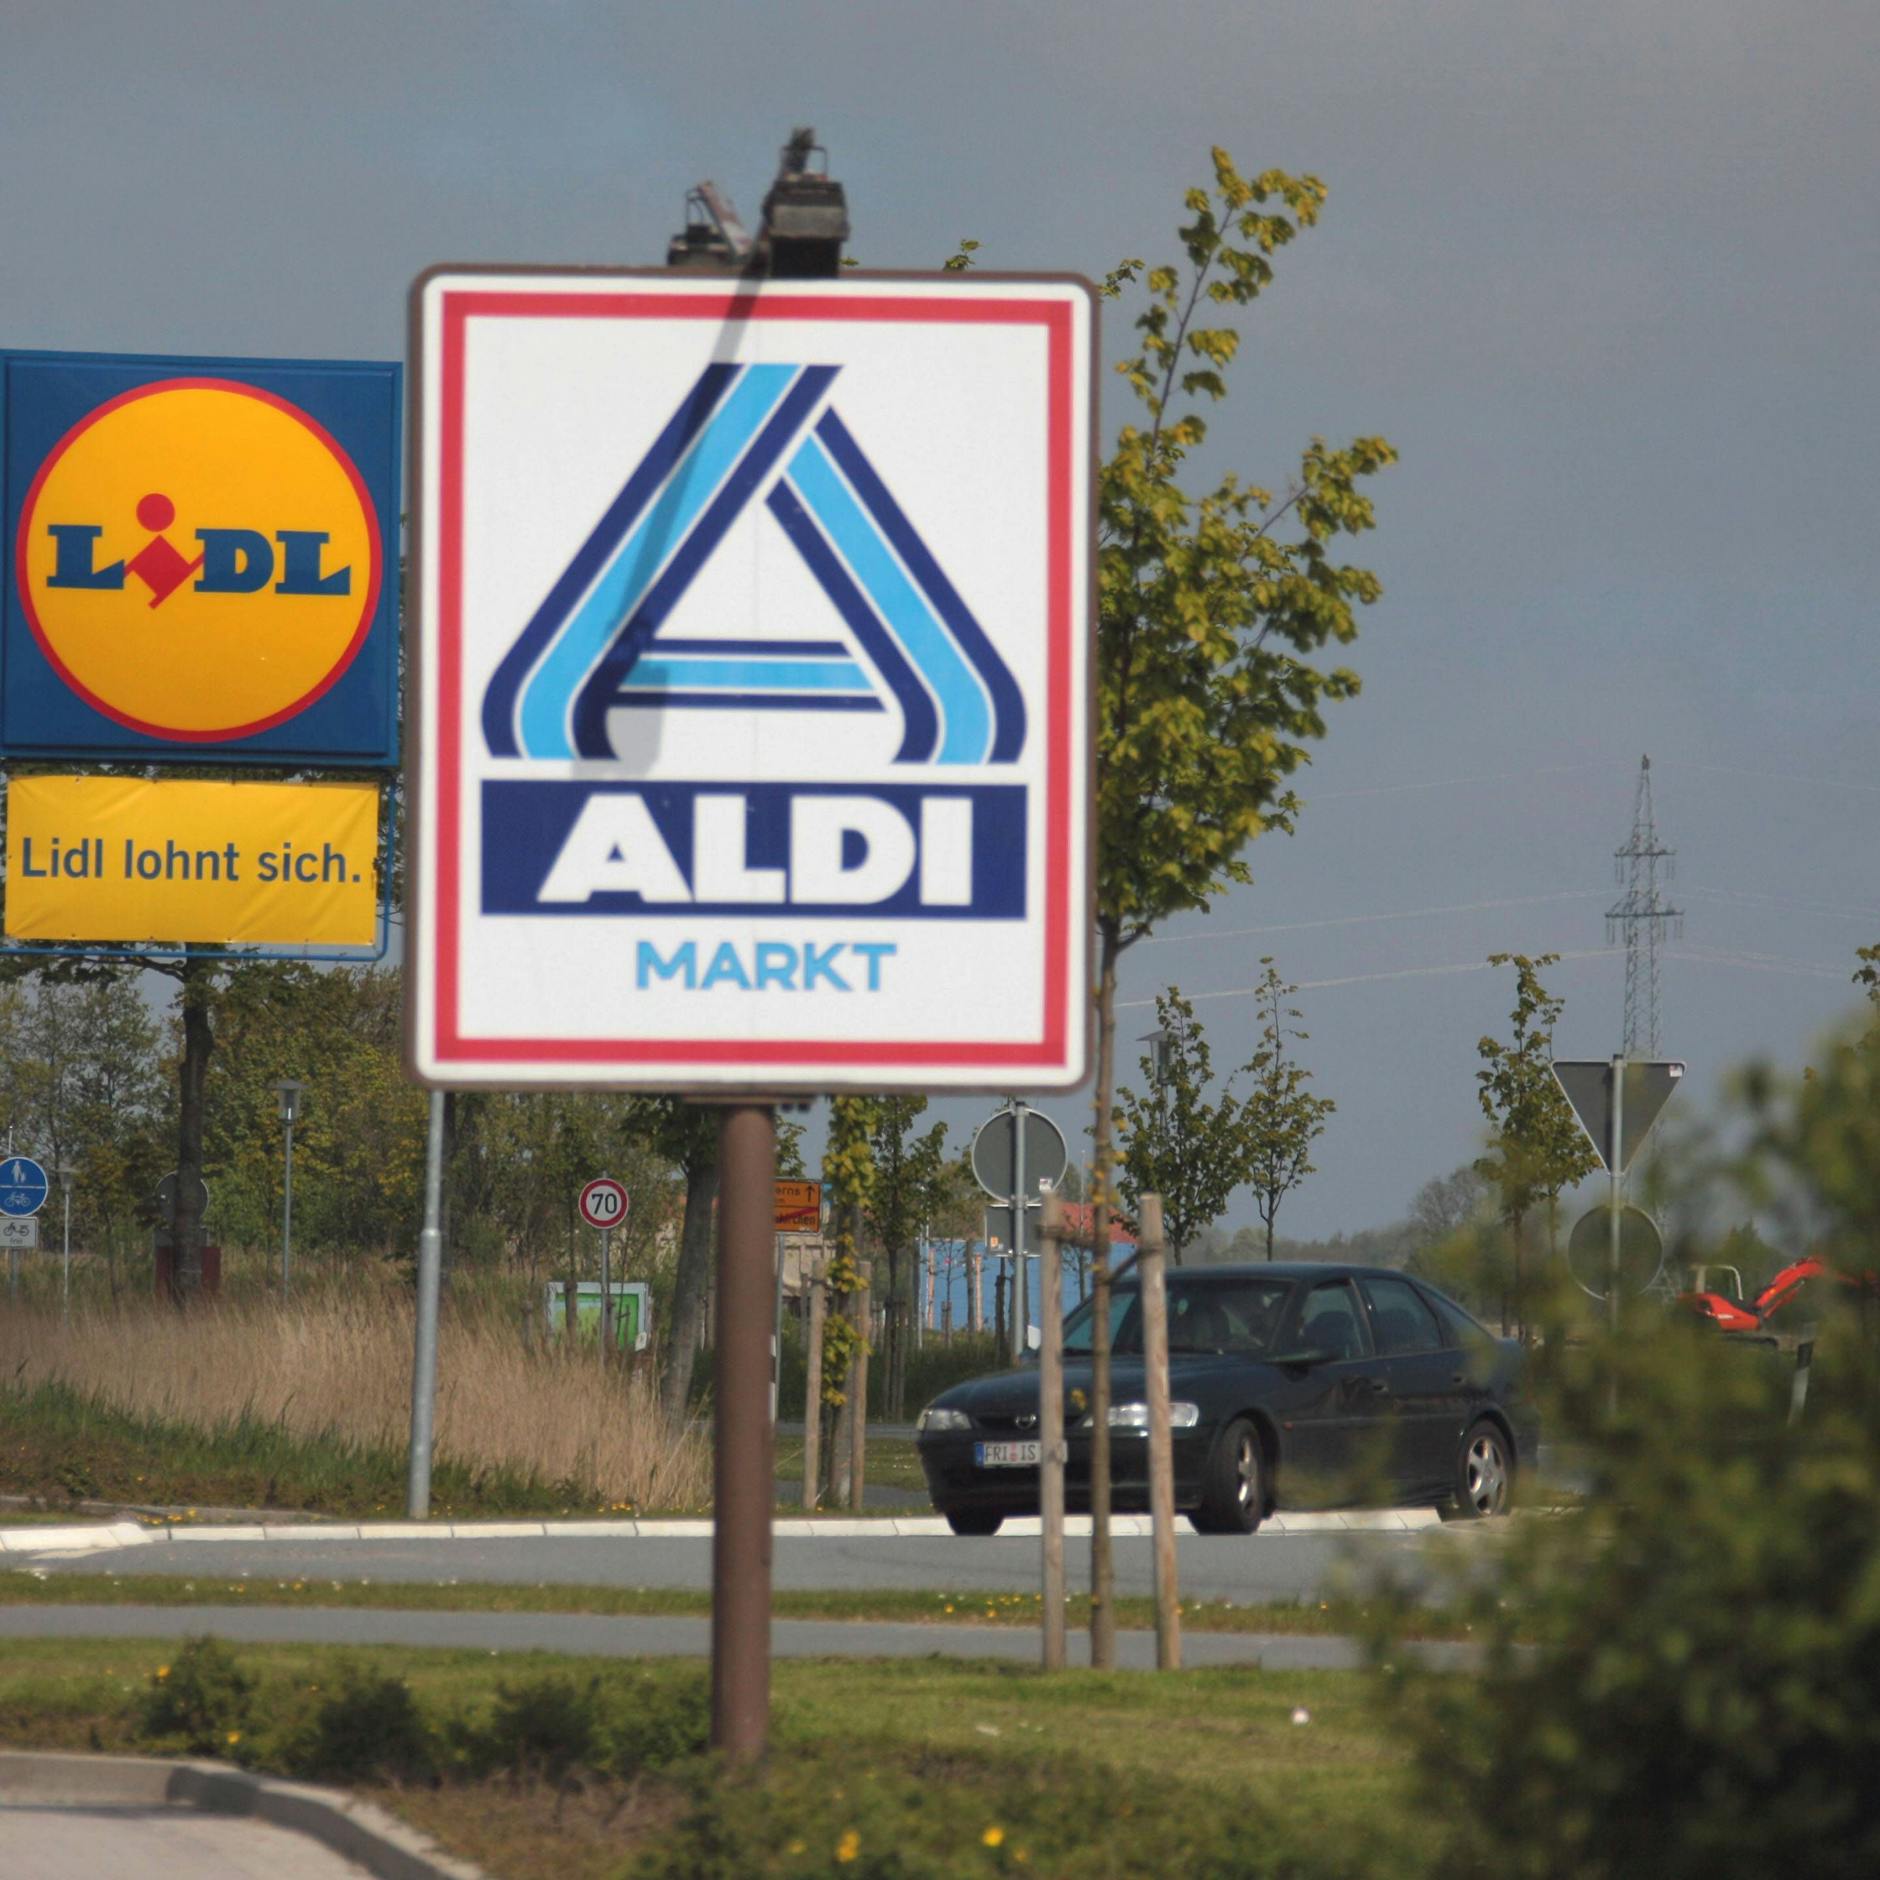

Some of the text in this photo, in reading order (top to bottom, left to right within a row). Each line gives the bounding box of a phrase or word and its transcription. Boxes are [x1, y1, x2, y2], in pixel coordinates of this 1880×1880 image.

[22, 837, 361, 883] Lidl lohnt sich.
[536, 792, 973, 906] ALDI
[635, 939, 898, 992] MARKT
[591, 1193, 618, 1215] 70
[985, 1445, 1008, 1461] FRI
